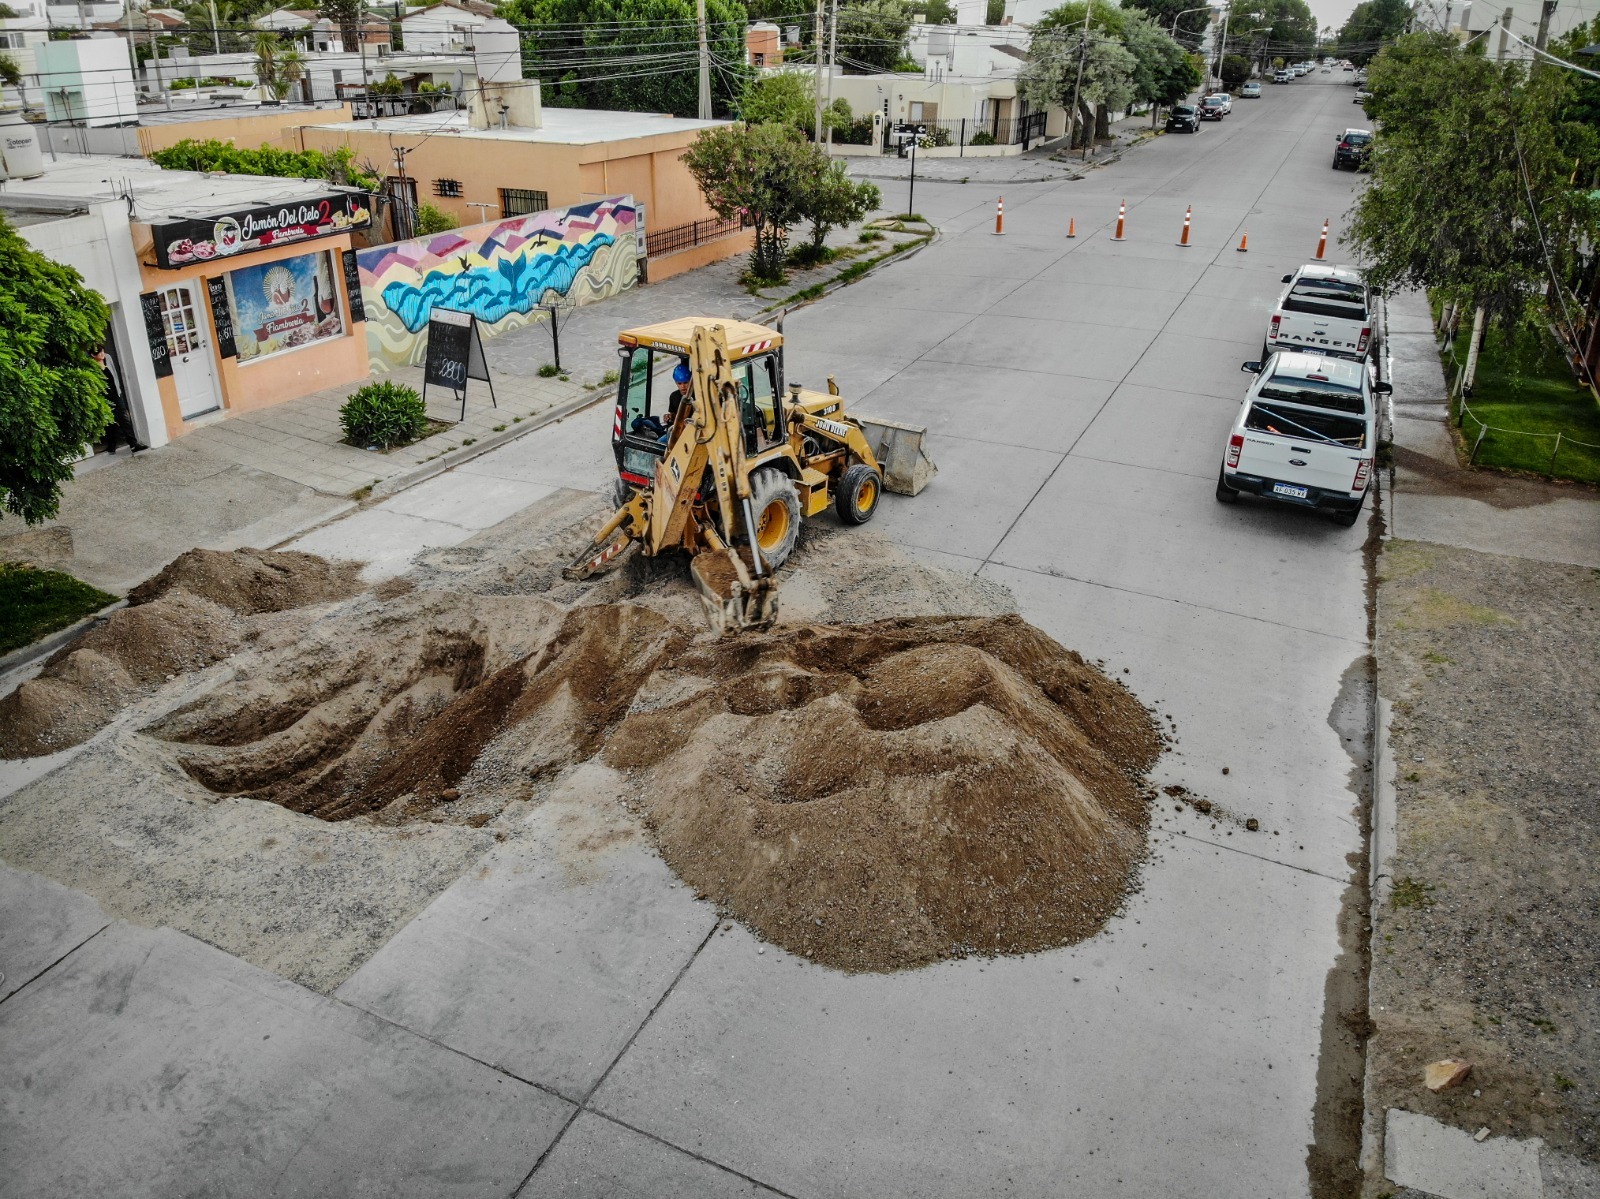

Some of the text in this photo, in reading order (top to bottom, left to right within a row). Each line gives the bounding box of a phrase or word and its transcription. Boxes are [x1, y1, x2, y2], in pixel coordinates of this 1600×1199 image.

[242, 200, 334, 240] Jamón Del Cielo 2
[301, 298, 310, 312] 2
[1279, 333, 1356, 348] RANGER
[816, 419, 830, 432] JOHN
[1246, 438, 1275, 446] RANGER
